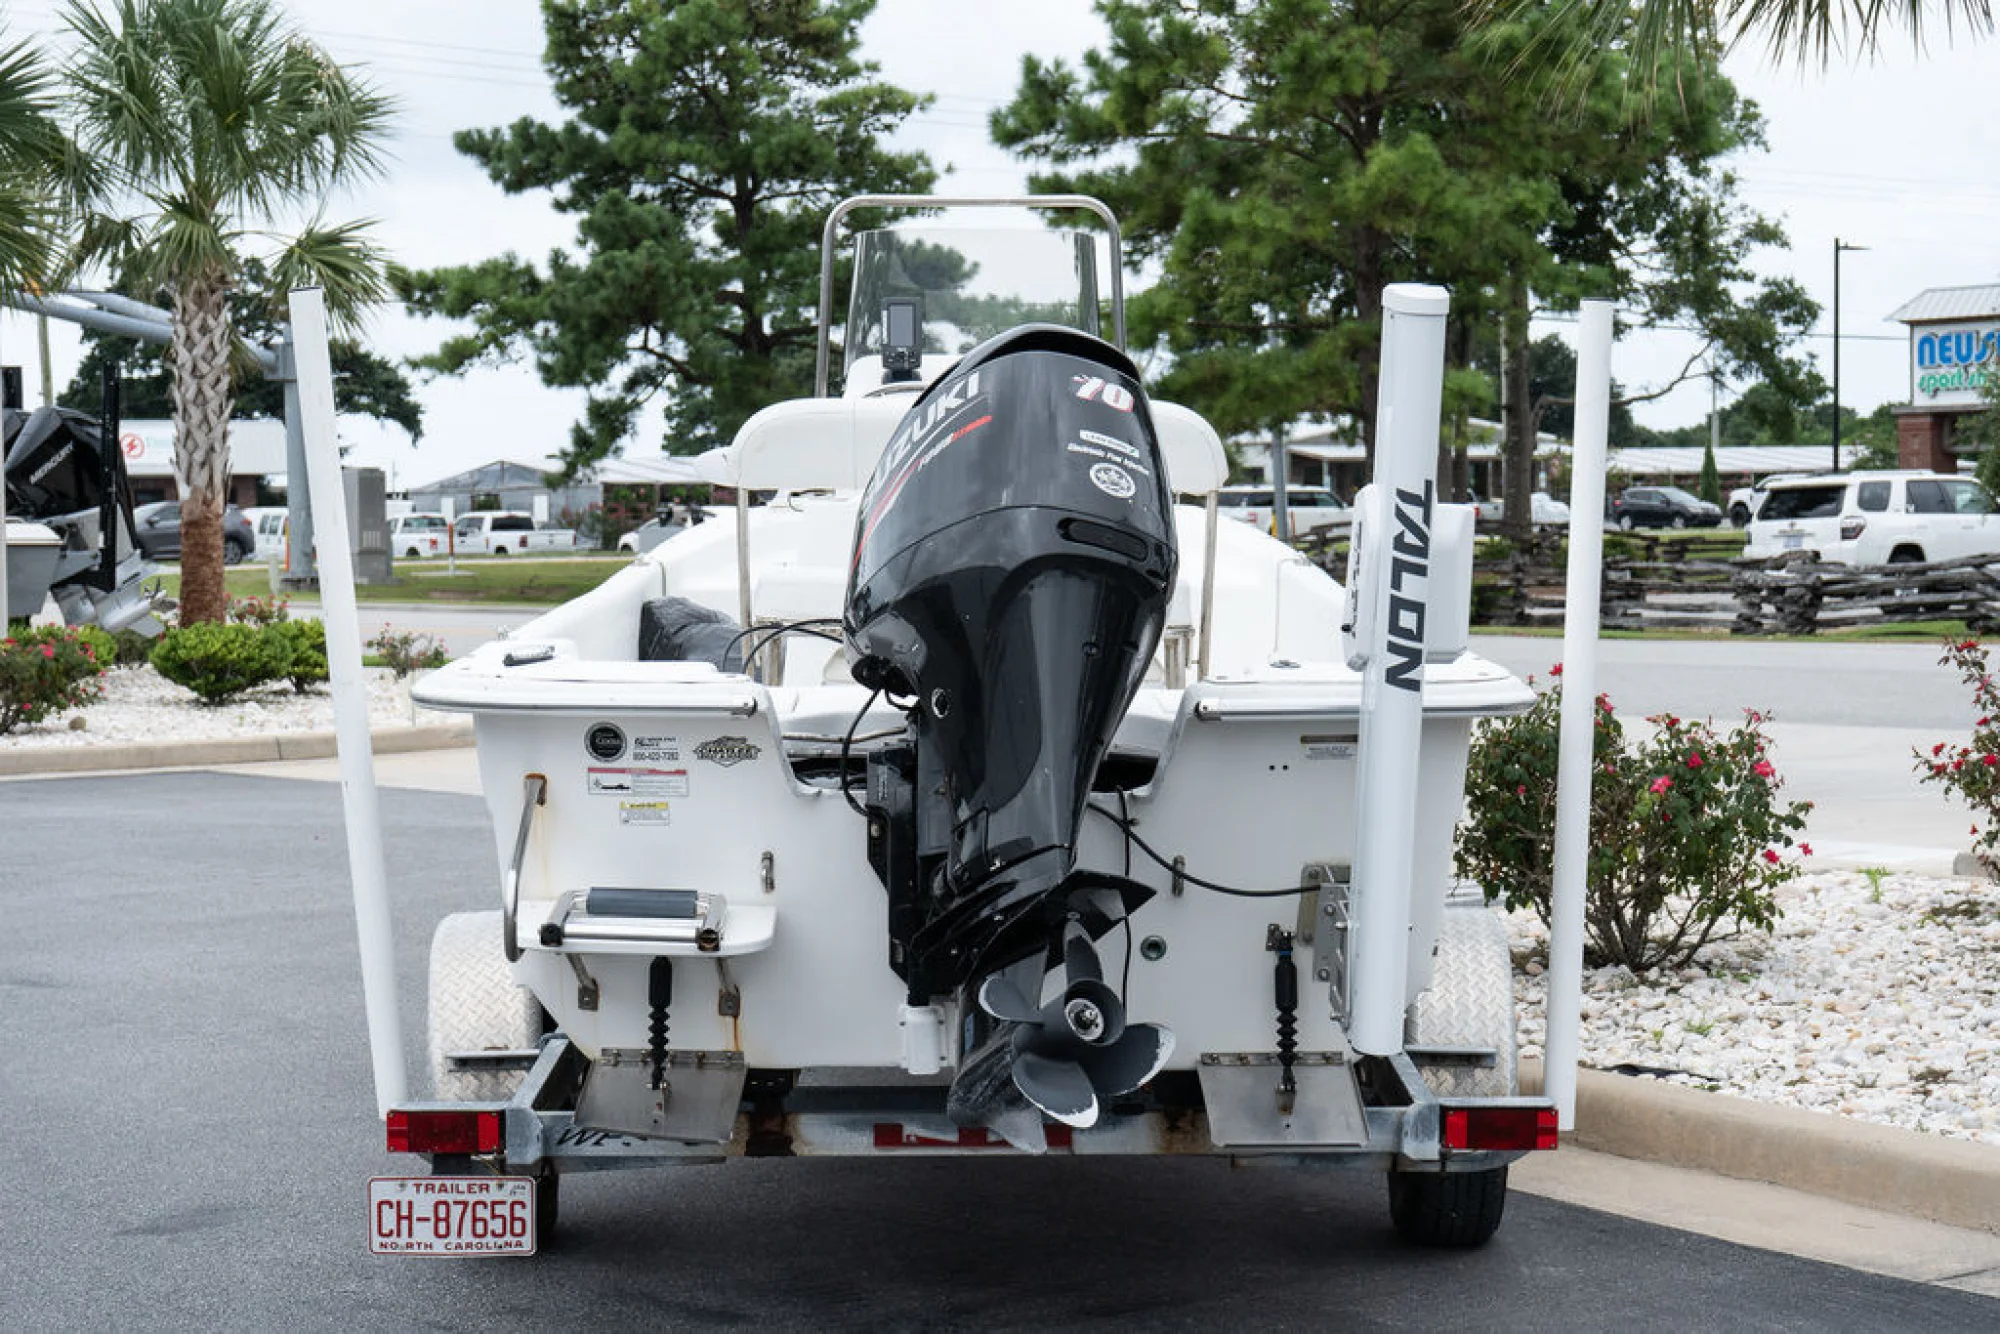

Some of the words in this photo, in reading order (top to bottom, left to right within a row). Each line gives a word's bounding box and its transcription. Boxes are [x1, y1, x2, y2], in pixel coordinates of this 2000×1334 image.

[1918, 331, 2000, 367] NEUS
[1072, 374, 1134, 412] 70
[1918, 368, 1963, 396] sport
[1384, 479, 1433, 692] TALON
[413, 1183, 490, 1194] TRAILER
[376, 1200, 527, 1239] CH-87656
[379, 1241, 432, 1250] NORTH
[444, 1240, 525, 1250] CAROLINA
